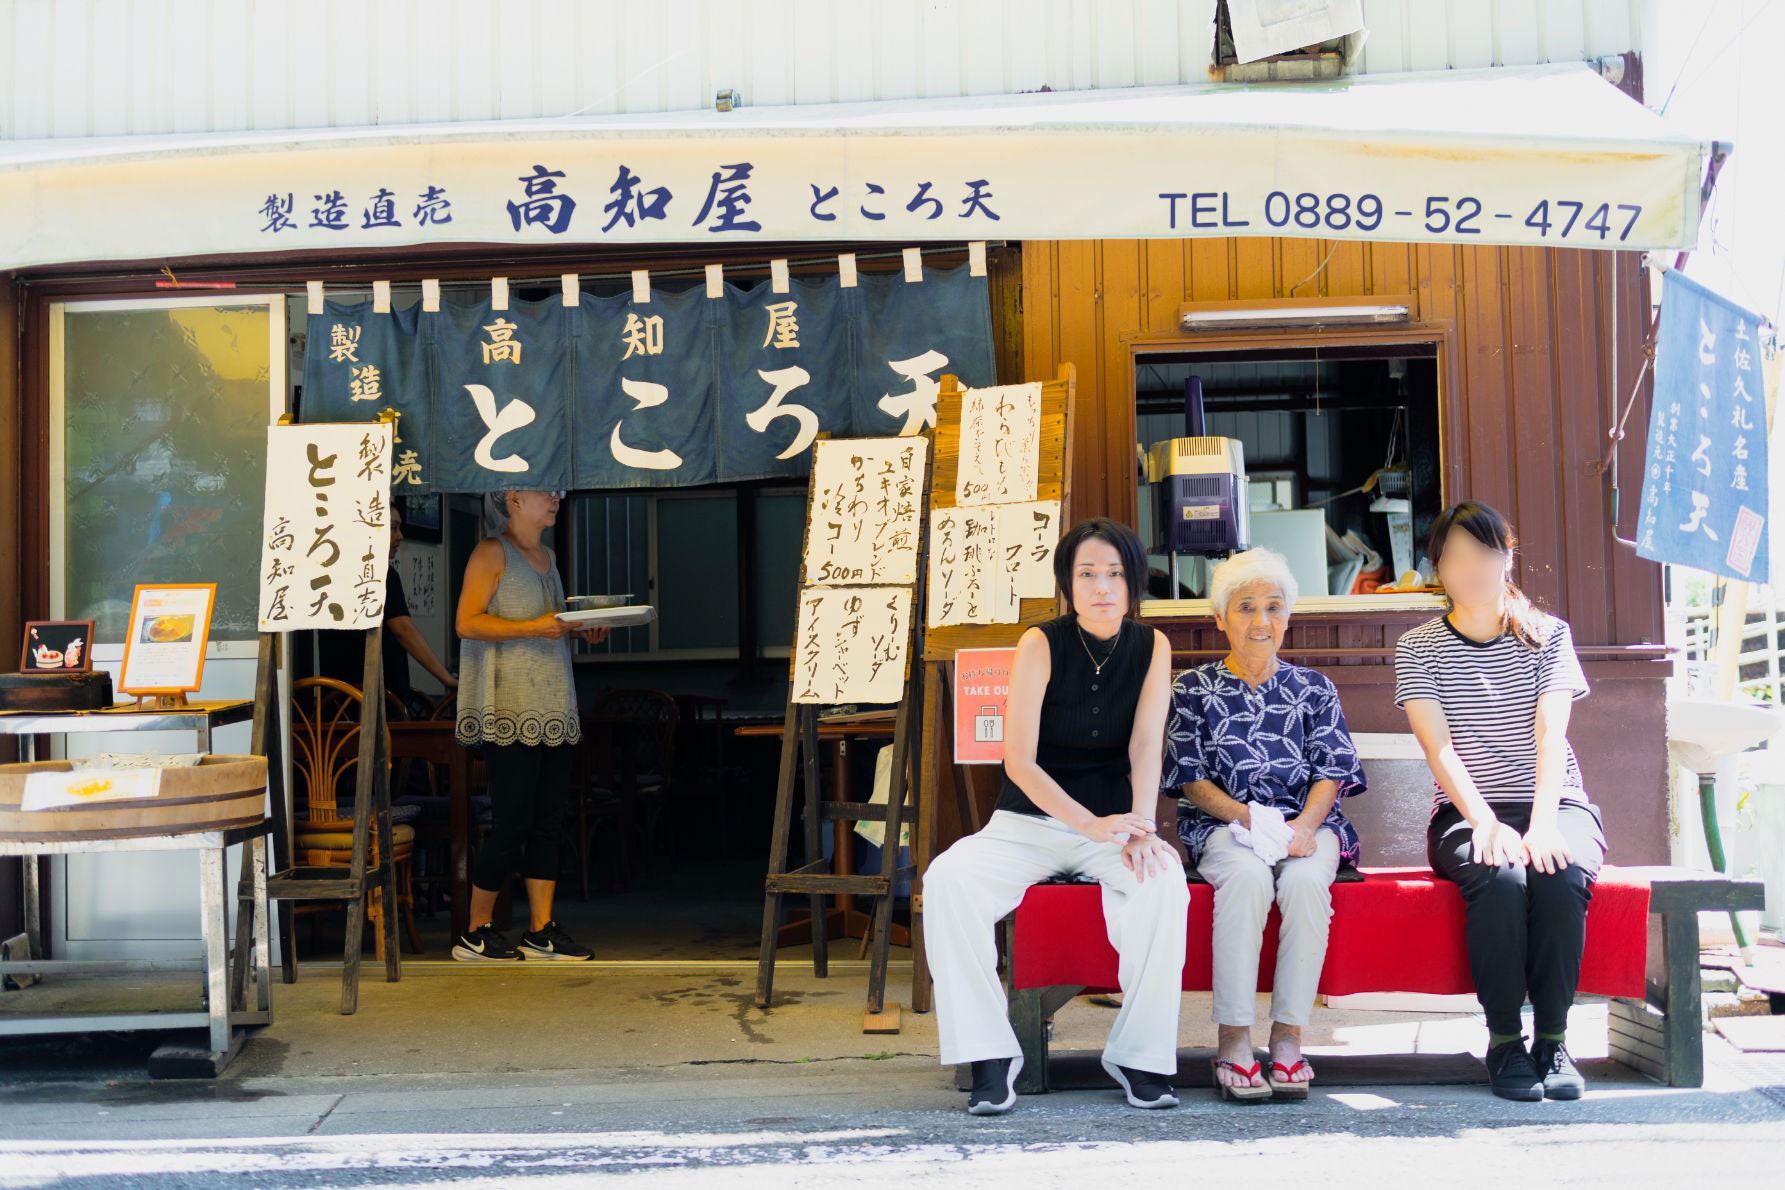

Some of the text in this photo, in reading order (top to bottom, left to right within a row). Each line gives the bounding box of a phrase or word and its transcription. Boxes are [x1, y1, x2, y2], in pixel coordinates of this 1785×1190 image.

[259, 186, 453, 233] 製造直売
[506, 163, 763, 234] 高知屋
[809, 179, 1001, 222] ところ天
[1158, 192, 1250, 229] TEL
[481, 302, 803, 366] 高知屋
[306, 443, 345, 621] ところ天
[1030, 510, 1051, 563] コーラ
[265, 516, 295, 621] 高知屋
[818, 560, 863, 582] 500円
[841, 595, 865, 638] ゆず
[799, 597, 825, 699] アイスクリーム
[963, 685, 1009, 696] TAKE OU
